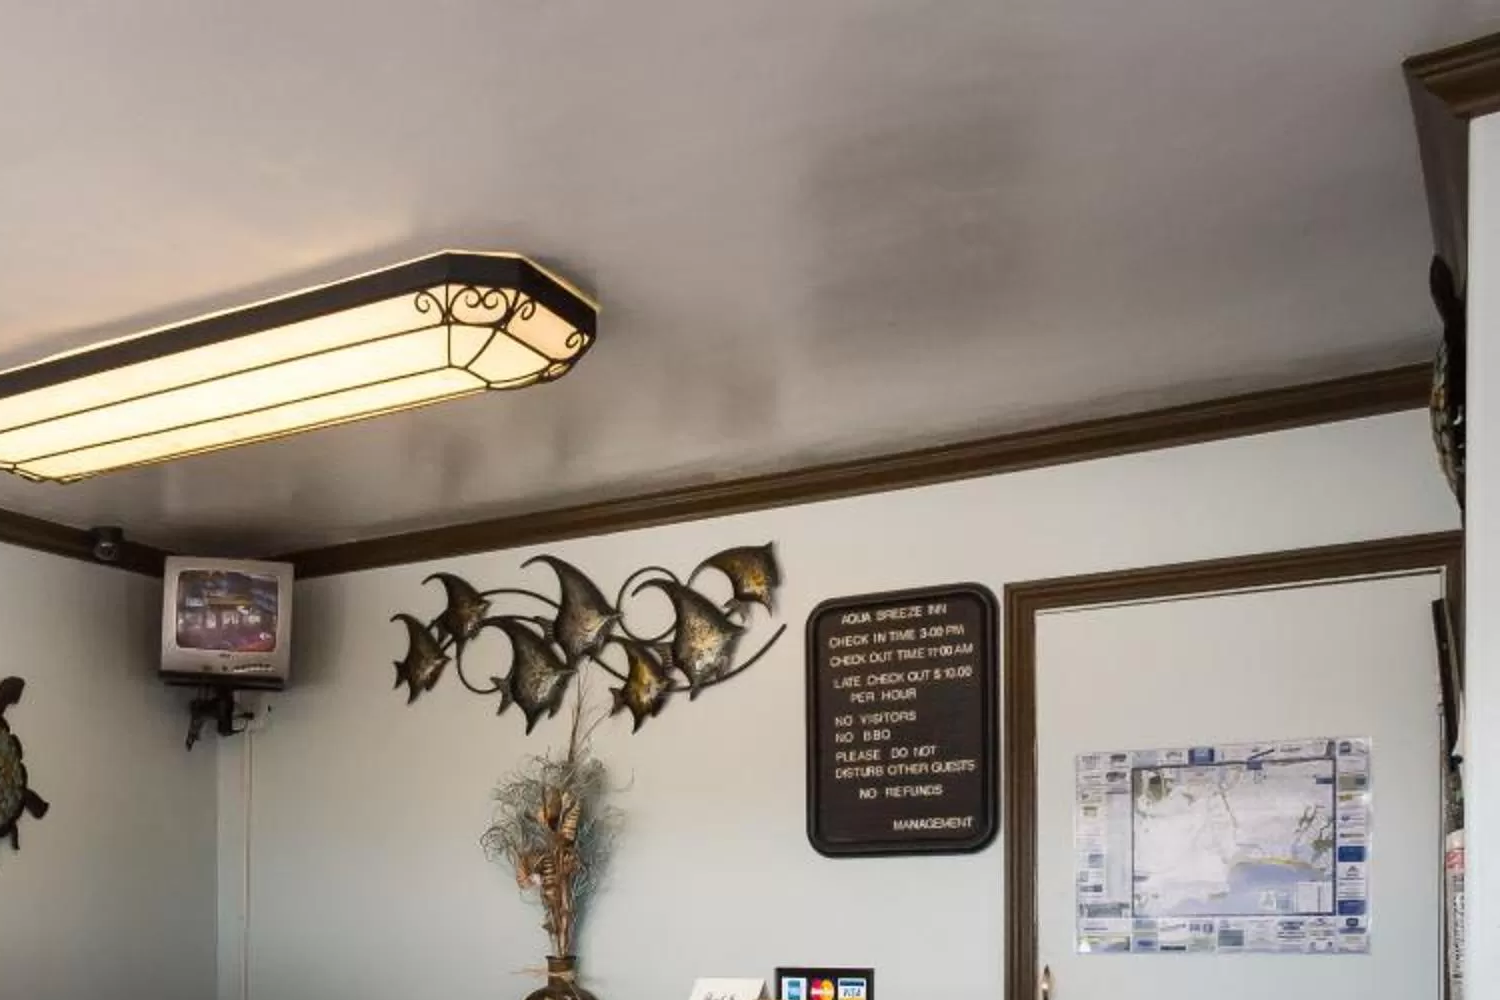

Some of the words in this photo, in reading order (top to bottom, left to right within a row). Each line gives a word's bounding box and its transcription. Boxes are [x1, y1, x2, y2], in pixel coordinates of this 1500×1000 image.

[876, 605, 923, 620] BREEZE
[927, 603, 947, 615] INN
[829, 633, 869, 649] CHECK
[873, 632, 887, 644] IN
[888, 629, 916, 642] TIME
[829, 653, 866, 668] CHECK
[869, 651, 893, 663] OUT
[896, 648, 925, 661] TIME
[954, 642, 973, 654] AM
[832, 676, 861, 689] LATE
[867, 672, 904, 686] CHECK
[907, 669, 931, 682] OUT
[850, 691, 875, 703] PER
[881, 687, 917, 701] HOUR
[835, 715, 853, 727] NO
[861, 710, 917, 725] VISITORS
[835, 731, 854, 743] NO
[835, 749, 880, 762] PLEASE
[891, 747, 909, 759] DO
[913, 745, 936, 757] NOT
[835, 765, 884, 779] DISTURB
[887, 763, 929, 776] OTHER
[931, 760, 975, 773] GUESTS
[859, 787, 877, 799] NO
[886, 784, 943, 798] REFUNDS
[893, 816, 973, 831] MANAGEMENT
